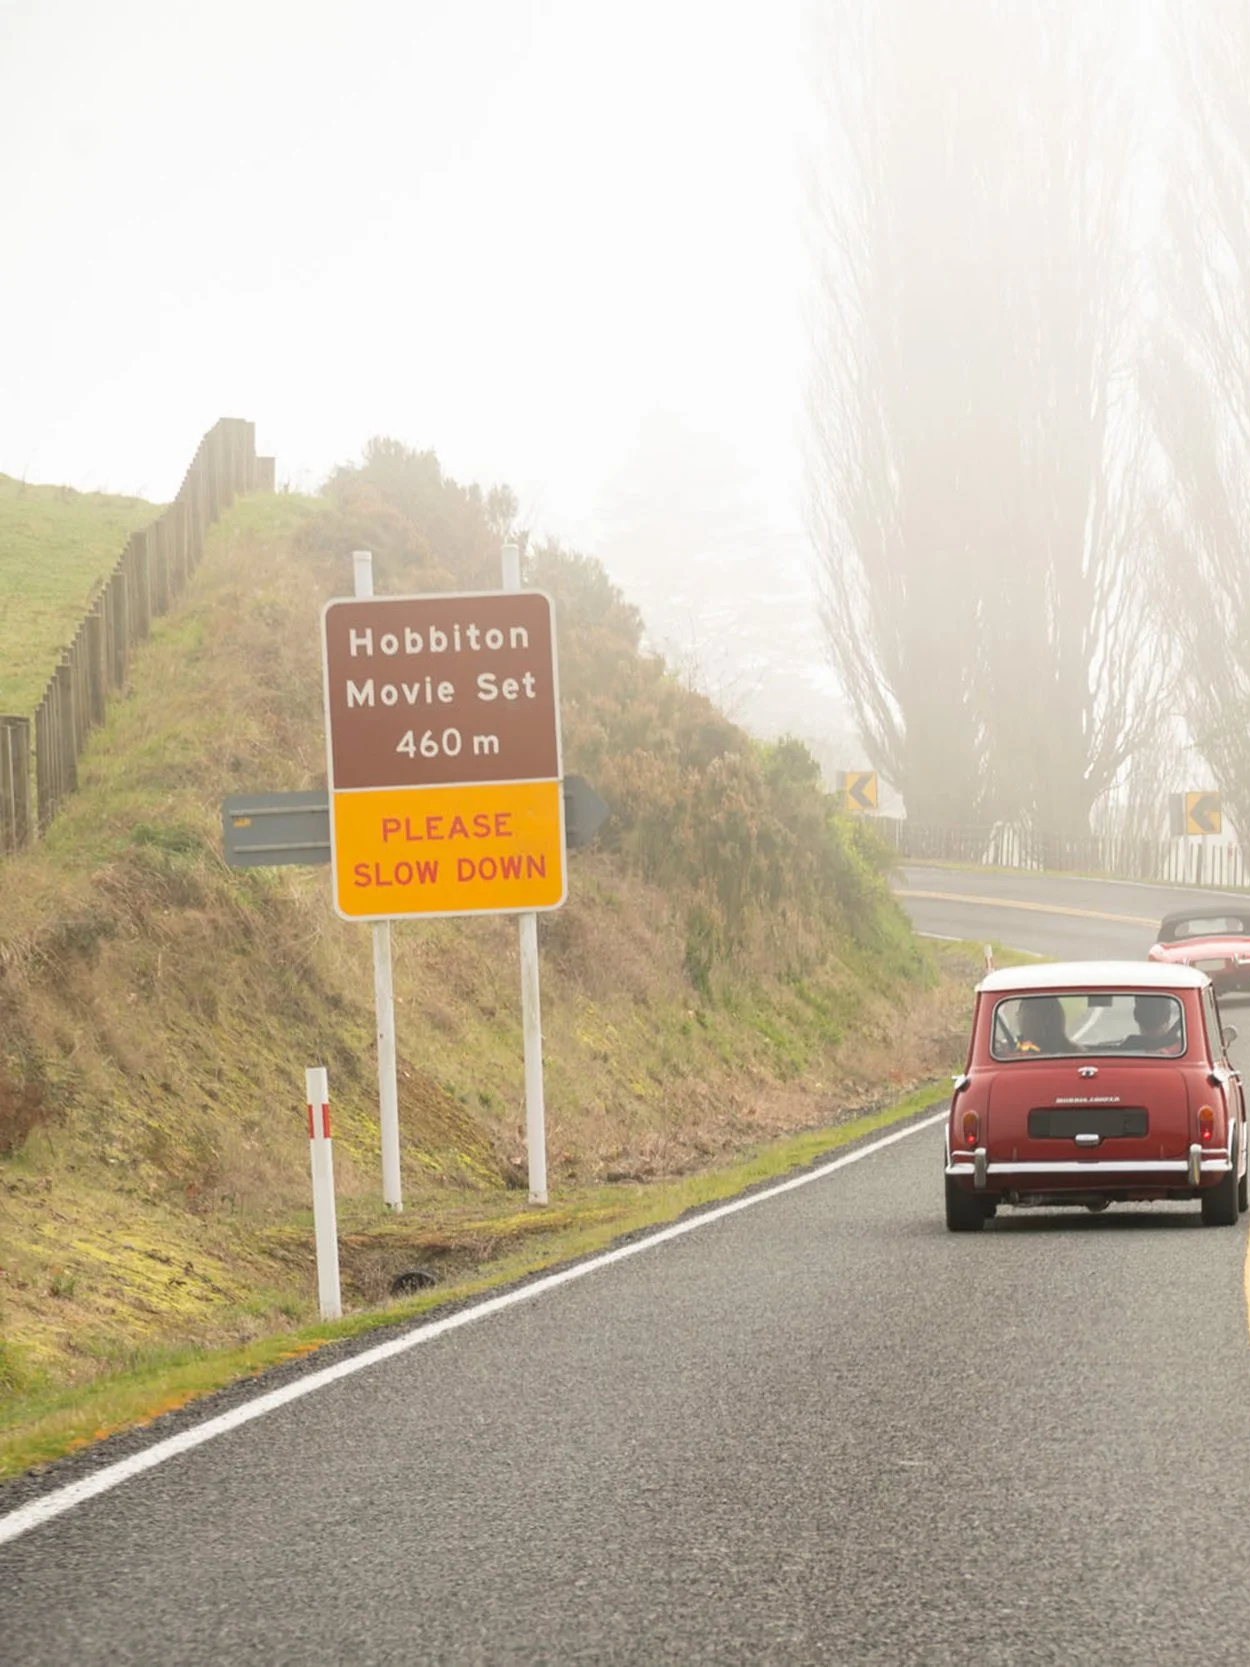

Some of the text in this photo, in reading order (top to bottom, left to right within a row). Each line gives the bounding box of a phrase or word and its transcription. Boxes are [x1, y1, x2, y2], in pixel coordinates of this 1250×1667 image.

[347, 623, 529, 657] Hobbiton
[346, 671, 536, 708] Movie Set
[395, 727, 500, 759] 460 m
[381, 812, 514, 843] PLEASE
[353, 854, 547, 888] SLOW DOWN
